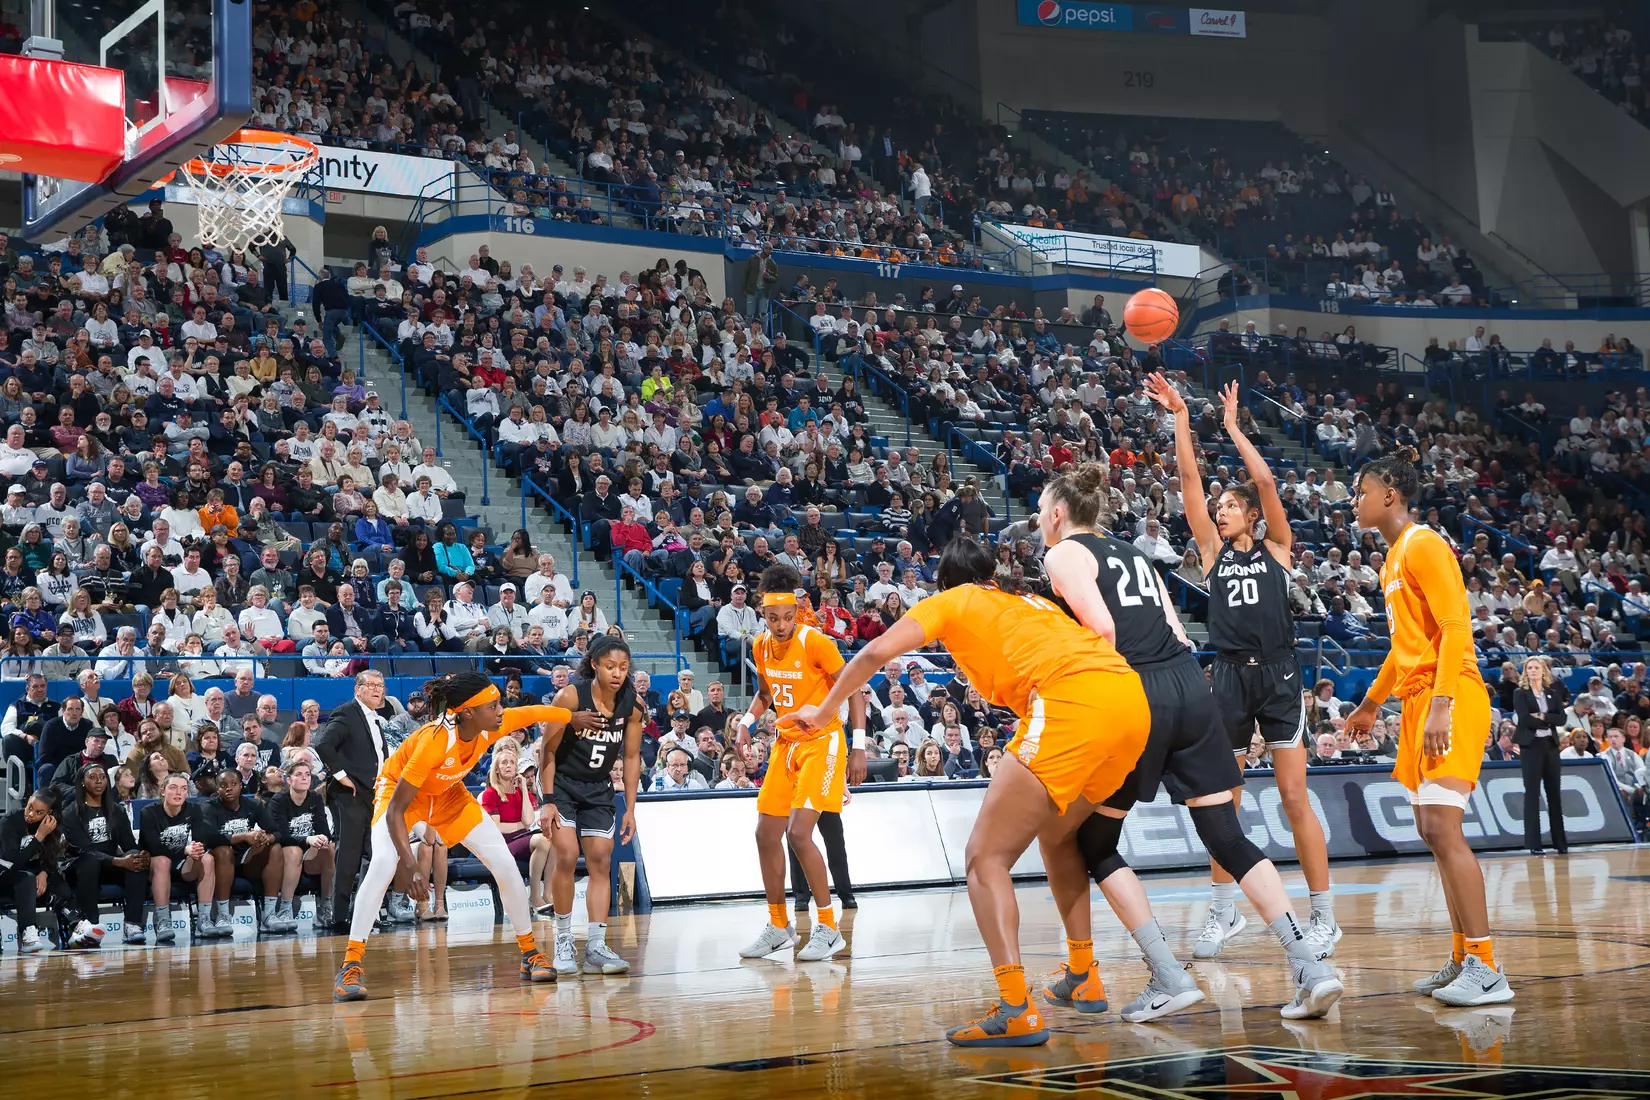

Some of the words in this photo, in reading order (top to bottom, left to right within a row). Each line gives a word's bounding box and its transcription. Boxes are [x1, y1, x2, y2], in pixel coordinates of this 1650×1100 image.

[1065, 7, 1115, 25] pepsi
[1200, 12, 1229, 26] Carvel
[1124, 71, 1153, 87] 219
[329, 191, 341, 201] EXIT
[504, 217, 535, 234] 116
[1016, 231, 1061, 246] ProHealth
[1120, 245, 1135, 253] local
[1137, 246, 1163, 255] doctrs
[877, 264, 900, 278] 117
[1319, 300, 1340, 313] 118
[46, 517, 62, 525] UCO
[1218, 561, 1268, 577] UCONN
[1106, 555, 1162, 607] 24
[1226, 578, 1260, 608] 20
[765, 668, 803, 680] ENNESSEE
[771, 683, 795, 708] 25
[588, 744, 607, 769] 5
